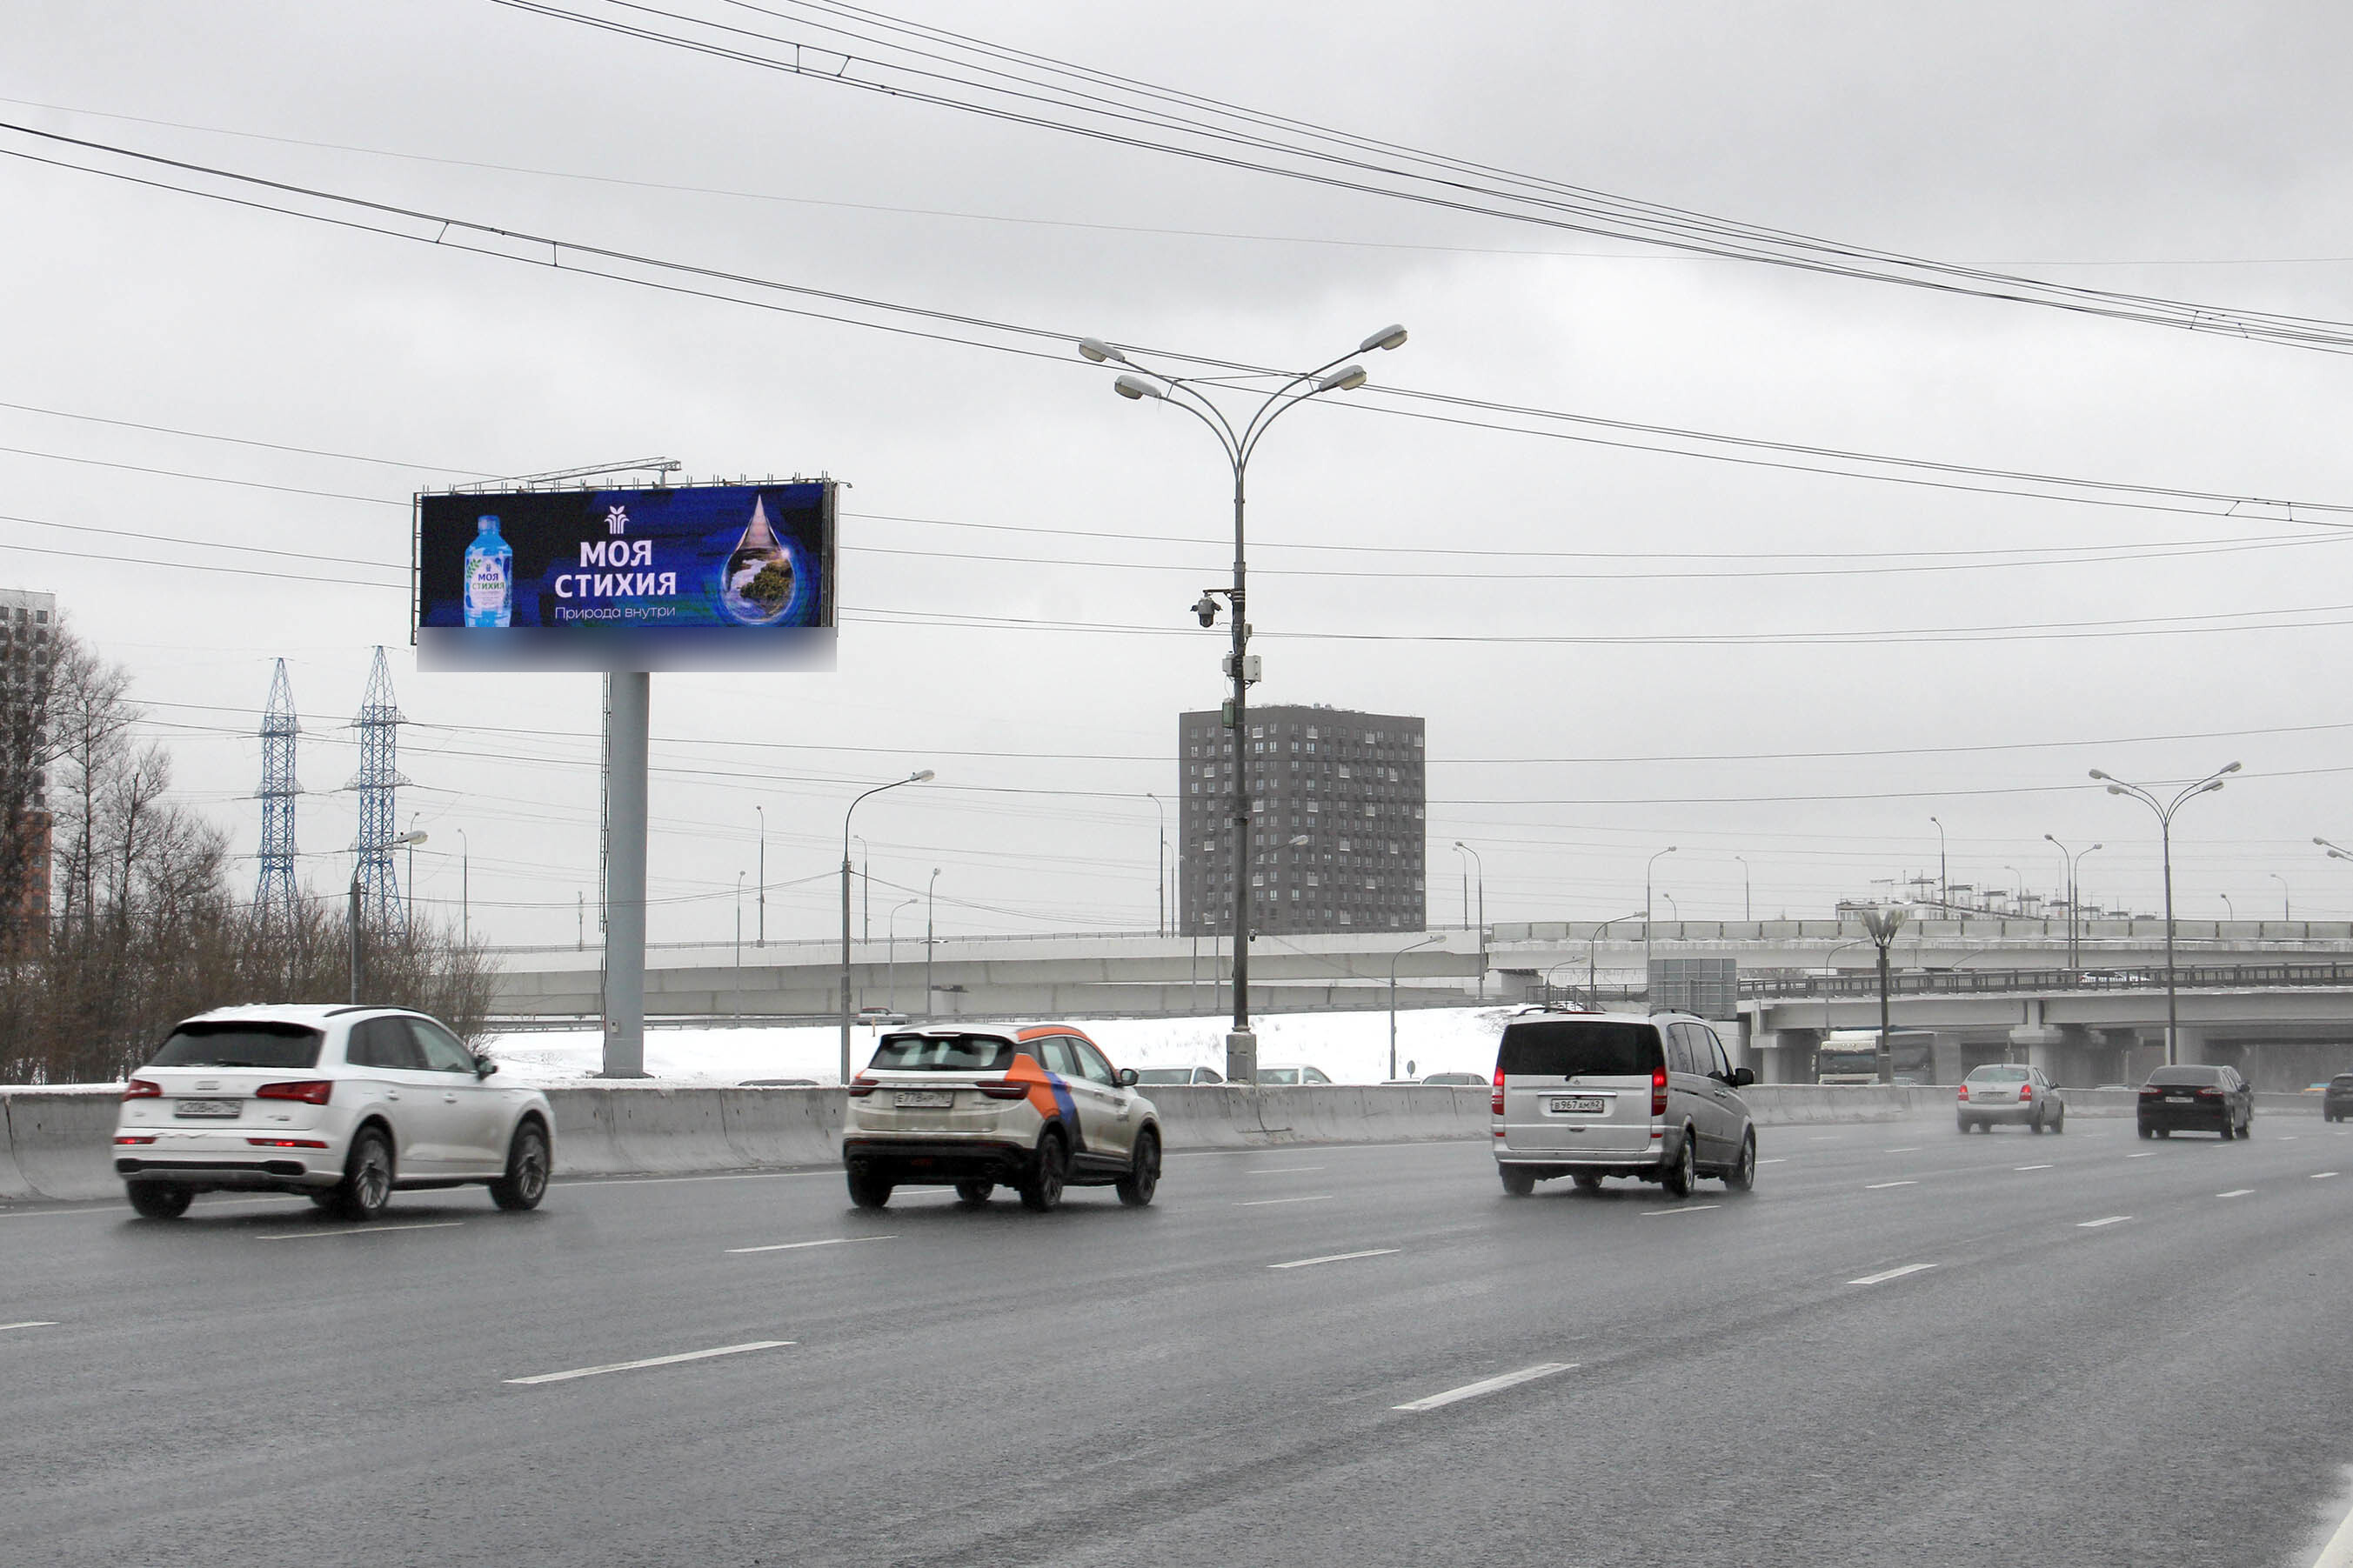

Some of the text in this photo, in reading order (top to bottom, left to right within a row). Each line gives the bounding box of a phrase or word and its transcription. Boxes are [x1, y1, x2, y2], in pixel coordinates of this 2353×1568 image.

[578, 539, 652, 568] МОЯ
[478, 573, 499, 582] МОЯ
[554, 571, 677, 597] СТИХИЯ
[471, 581, 505, 591] СТИХИЯ
[554, 605, 676, 621] Природа внутри
